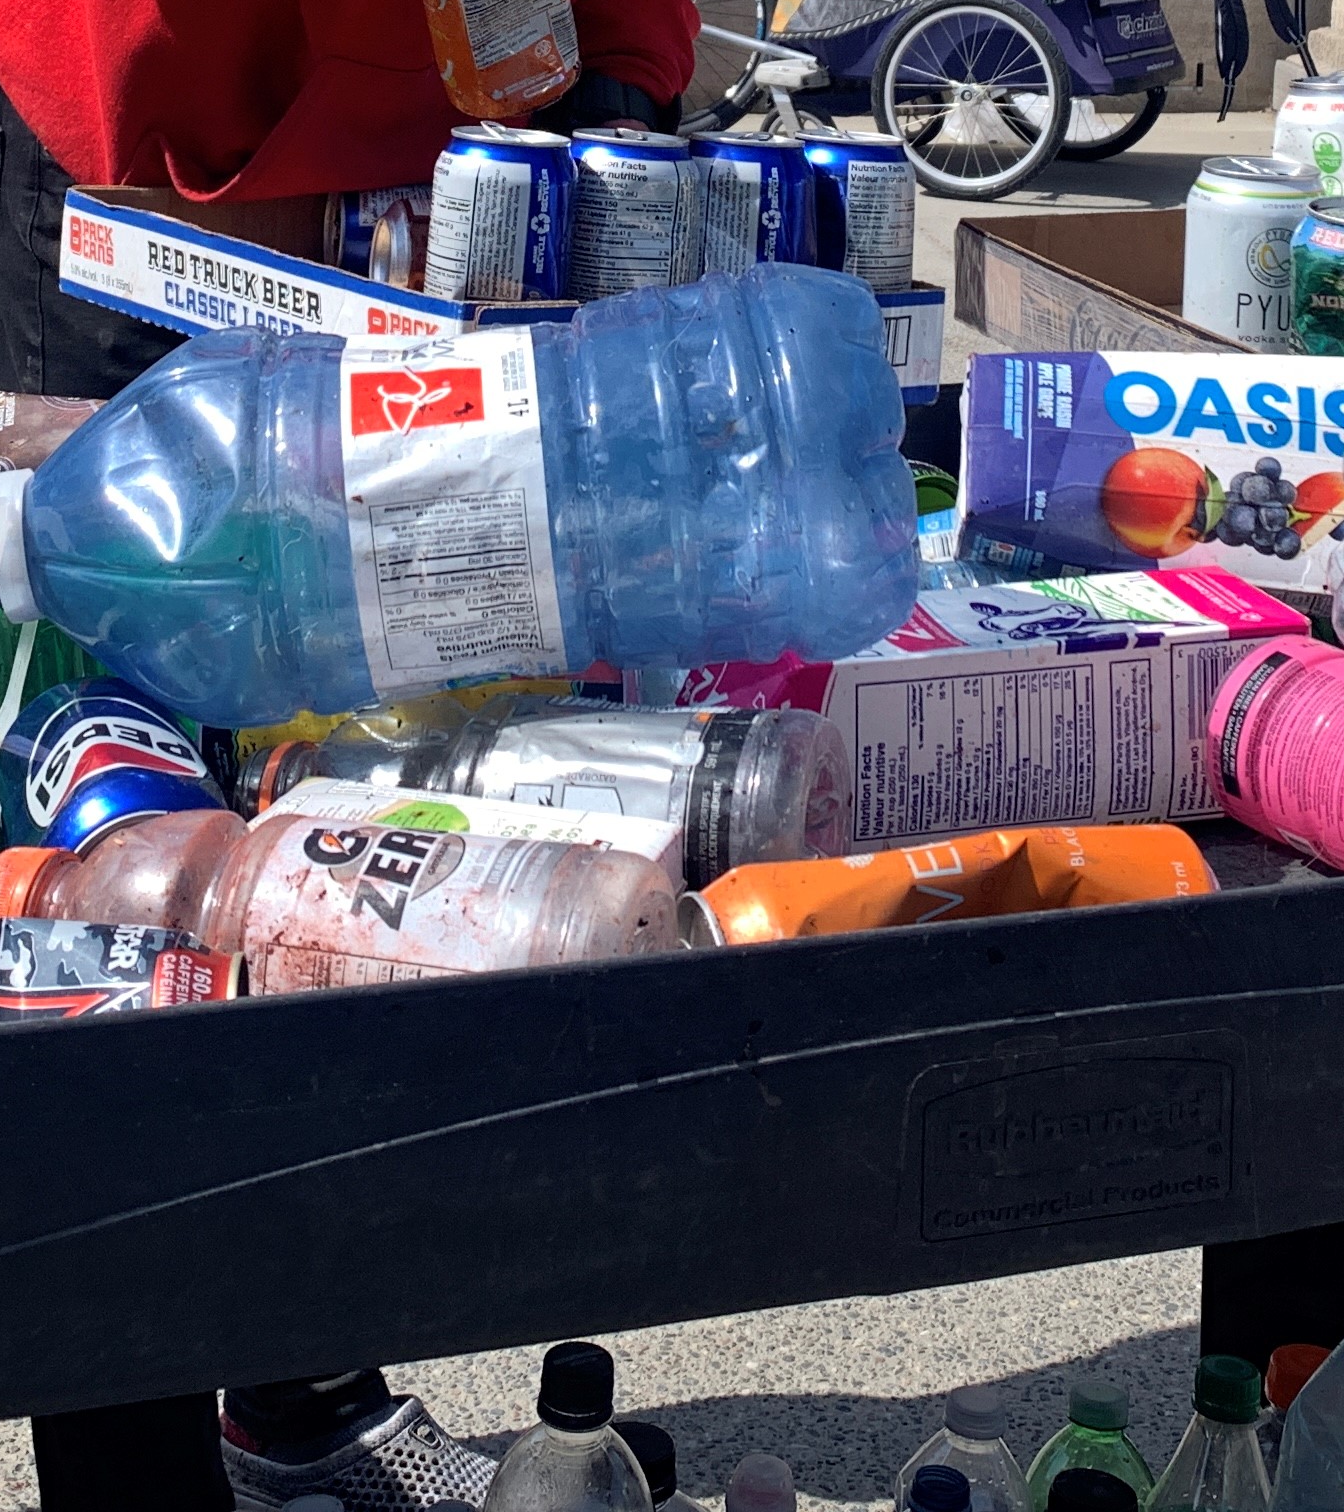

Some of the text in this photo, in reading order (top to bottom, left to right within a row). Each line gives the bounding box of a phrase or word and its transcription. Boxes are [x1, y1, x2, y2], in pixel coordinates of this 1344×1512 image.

[607, 170, 648, 182] nutritive
[621, 161, 647, 171] Facts
[537, 168, 551, 212] RECYCLER
[83, 220, 114, 246] PACK
[535, 235, 546, 274] RECYCLE
[147, 241, 323, 324] RED TRUCK BEER
[164, 280, 237, 326] CLASSIC
[36, 723, 197, 812] PEPSI
[858, 744, 872, 836] Nutrition Facts
[872, 742, 886, 835] Valeur nutritive
[908, 793, 919, 831] Calories
[190, 965, 214, 995] 160
